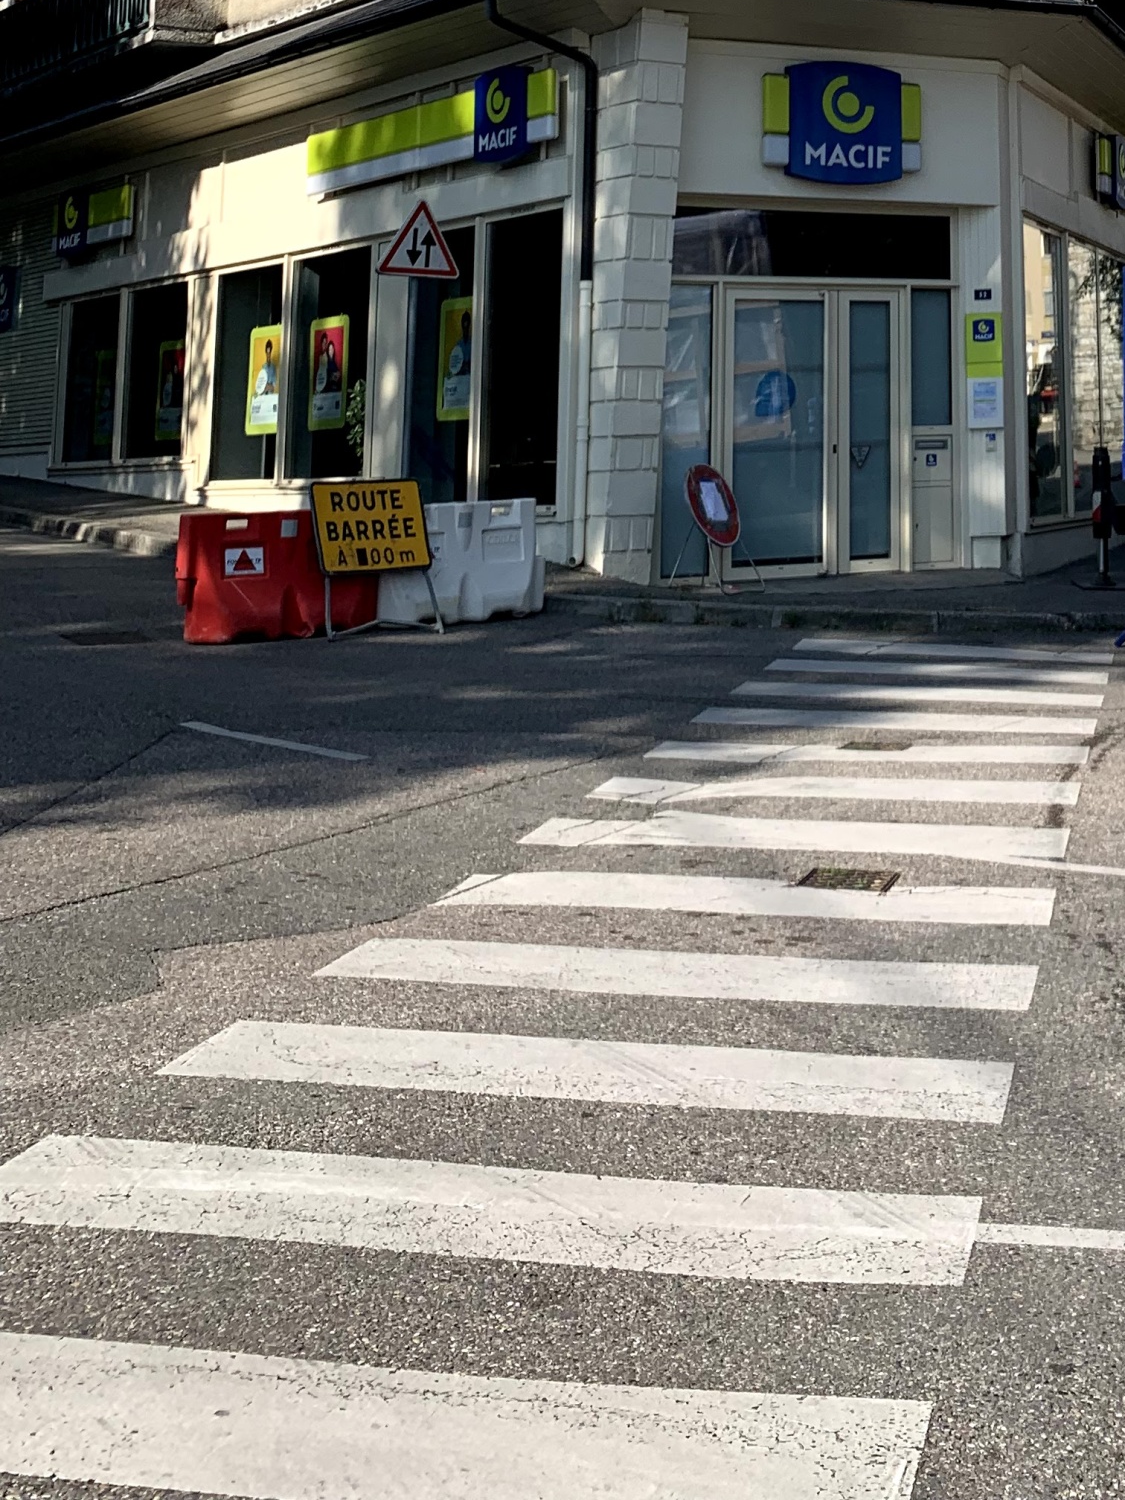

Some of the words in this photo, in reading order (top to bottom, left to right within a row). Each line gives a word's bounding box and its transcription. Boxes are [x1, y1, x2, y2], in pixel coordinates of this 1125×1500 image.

[478, 125, 518, 153] MACIF
[804, 141, 892, 169] MACIF
[58, 232, 81, 250] MACIF
[330, 489, 403, 512] ROUTE
[326, 514, 416, 541] BARRÉE
[338, 545, 348, 566] À
[356, 547, 395, 566] 00
[400, 550, 415, 563] m
